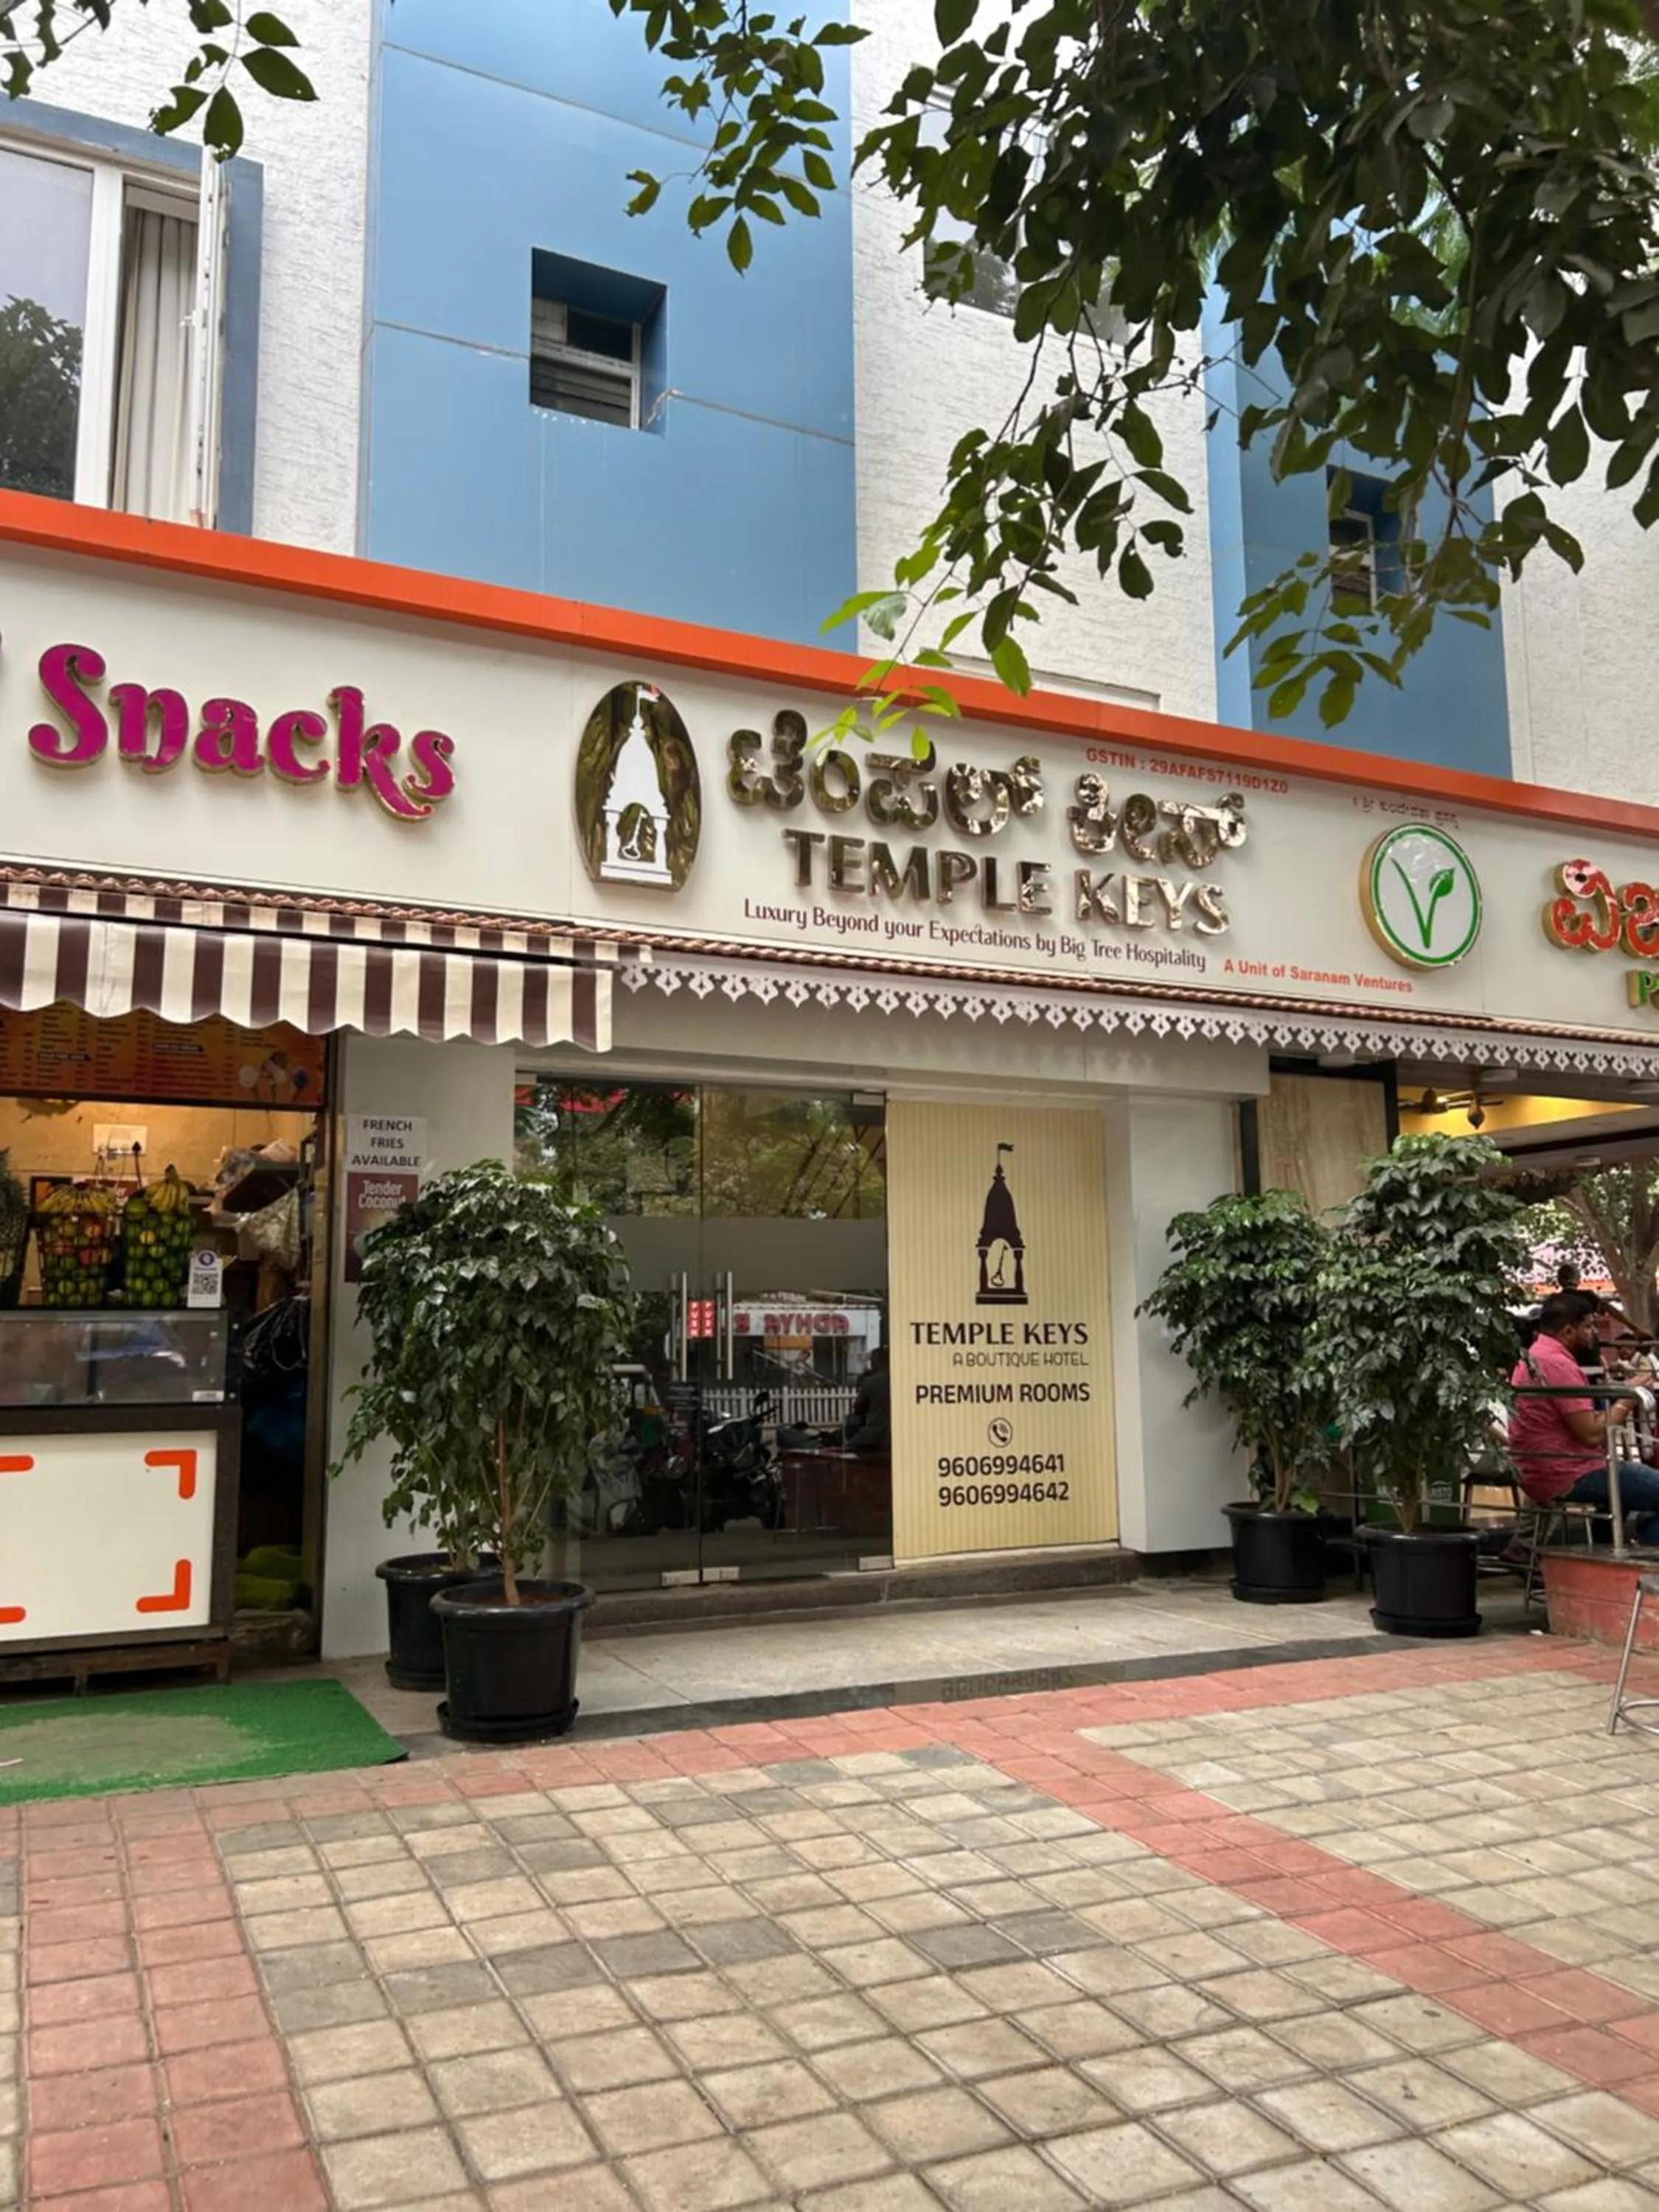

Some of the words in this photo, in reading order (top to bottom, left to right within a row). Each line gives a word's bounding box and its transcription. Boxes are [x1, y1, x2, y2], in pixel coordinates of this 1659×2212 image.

[28, 643, 456, 821] Snacks
[1086, 748, 1136, 768] GSTIN
[782, 828, 1052, 914] TEMPLE
[1074, 869, 1230, 936] KEYS
[745, 898, 807, 930] Luxury
[813, 906, 879, 934] Beyond
[884, 922, 923, 940] your
[929, 920, 1032, 950] Expectations
[1036, 933, 1056, 957] by
[1061, 935, 1085, 960] Big
[1092, 939, 1121, 960] Tree
[1127, 943, 1206, 972] Hospitality
[1224, 959, 1234, 973] A
[1238, 960, 1267, 977] Unit
[1272, 964, 1286, 978] of
[1290, 967, 1350, 986] Saranam
[1354, 973, 1413, 993] Ventures
[363, 1119, 412, 1132] FRENCH
[370, 1136, 405, 1150] FRIES
[352, 1155, 421, 1167] AVAILABLE
[363, 1180, 403, 1196] Tender
[910, 1322, 1015, 1345] TEMPLE
[1023, 1322, 1088, 1346] KEYS
[953, 1352, 963, 1366] A
[966, 1352, 1040, 1368] BOUTIQUE
[1043, 1352, 1089, 1366] HOTEL
[916, 1383, 1014, 1405] PREMIUM
[1020, 1382, 1091, 1402] ROOMS
[938, 1454, 1065, 1477] 9606994641
[939, 1481, 1069, 1506] 9606994642
